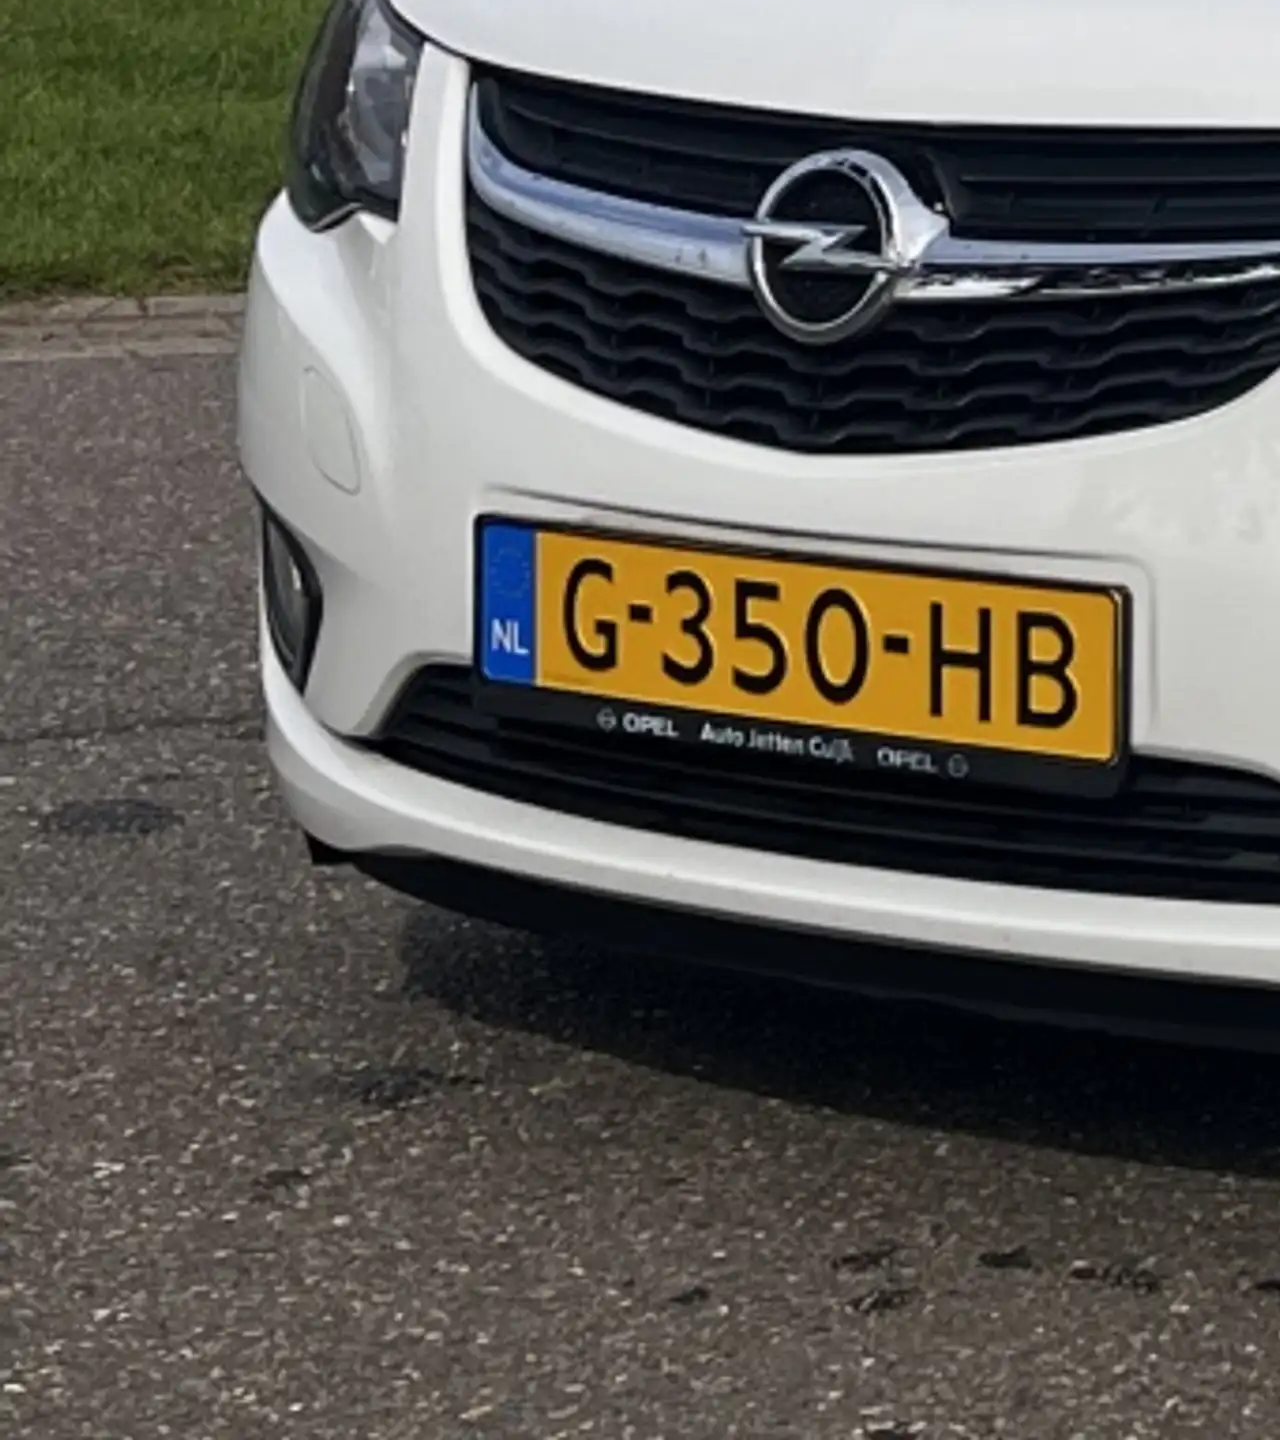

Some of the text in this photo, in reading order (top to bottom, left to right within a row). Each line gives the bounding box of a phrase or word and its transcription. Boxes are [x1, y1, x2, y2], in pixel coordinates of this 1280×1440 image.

[491, 617, 530, 656] NL
[563, 558, 1078, 729] G-350-HB
[622, 712, 680, 738] OPEL
[701, 720, 744, 748] Auto
[876, 746, 938, 774] OPEL
